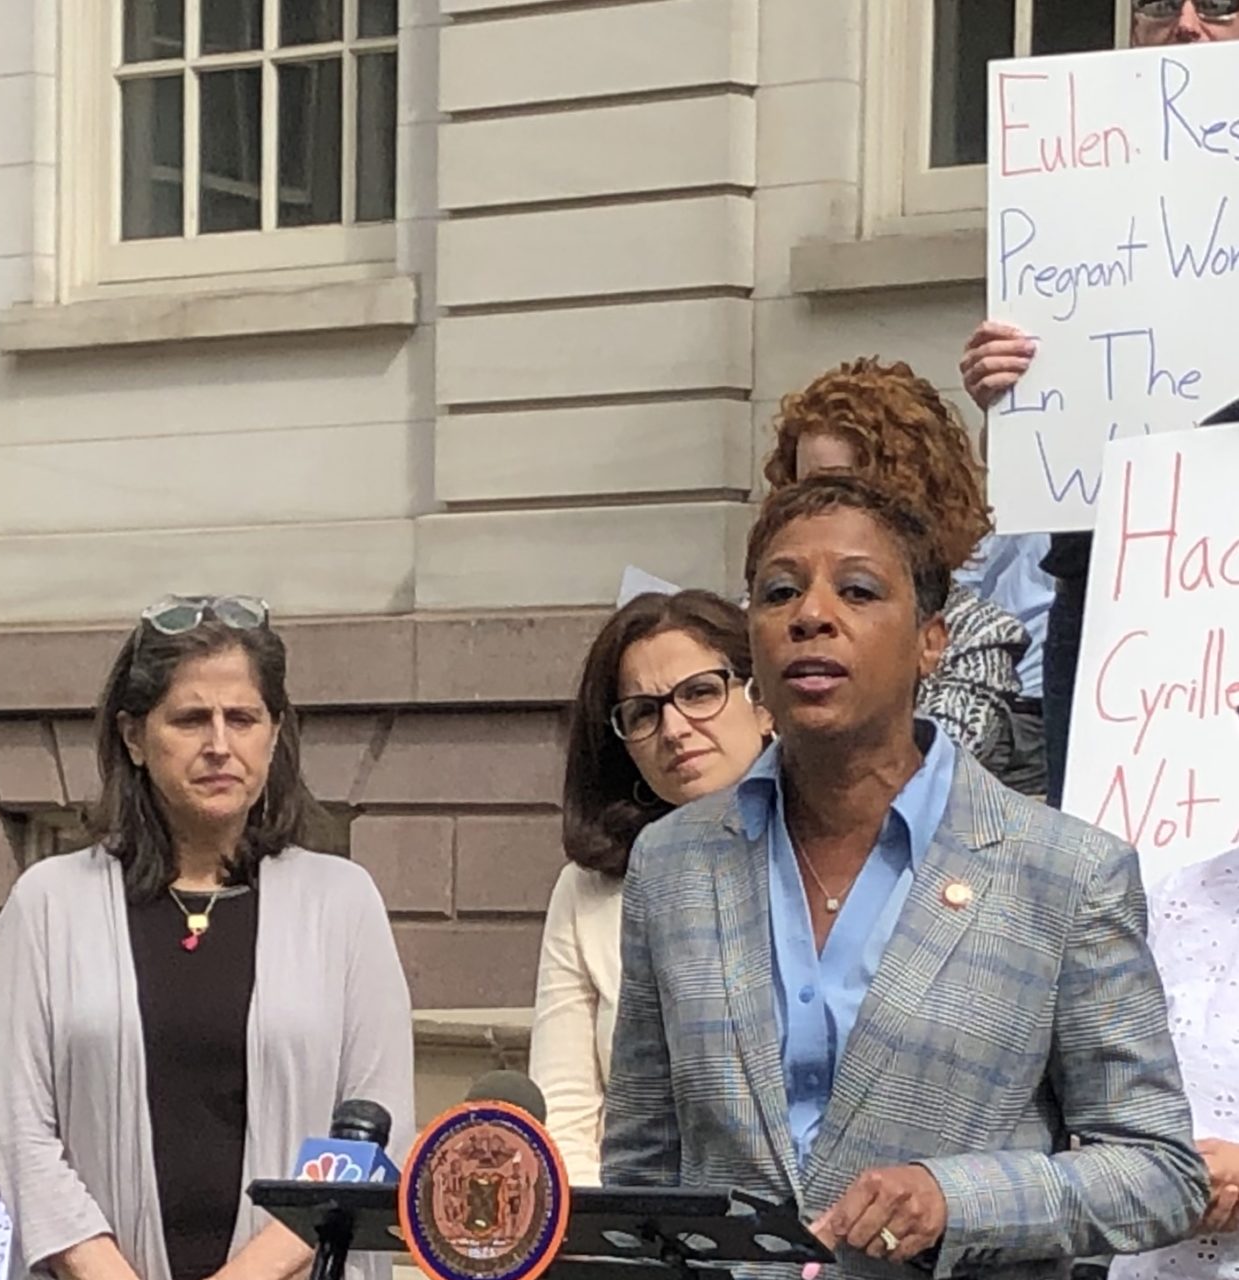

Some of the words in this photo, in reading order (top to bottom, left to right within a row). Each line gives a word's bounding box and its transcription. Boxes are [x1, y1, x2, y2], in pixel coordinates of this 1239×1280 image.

[1000, 207, 1148, 321] Pregnant
[1089, 327, 1202, 401] The
[1095, 627, 1239, 756] Cyrille
[1093, 758, 1221, 848] Not
